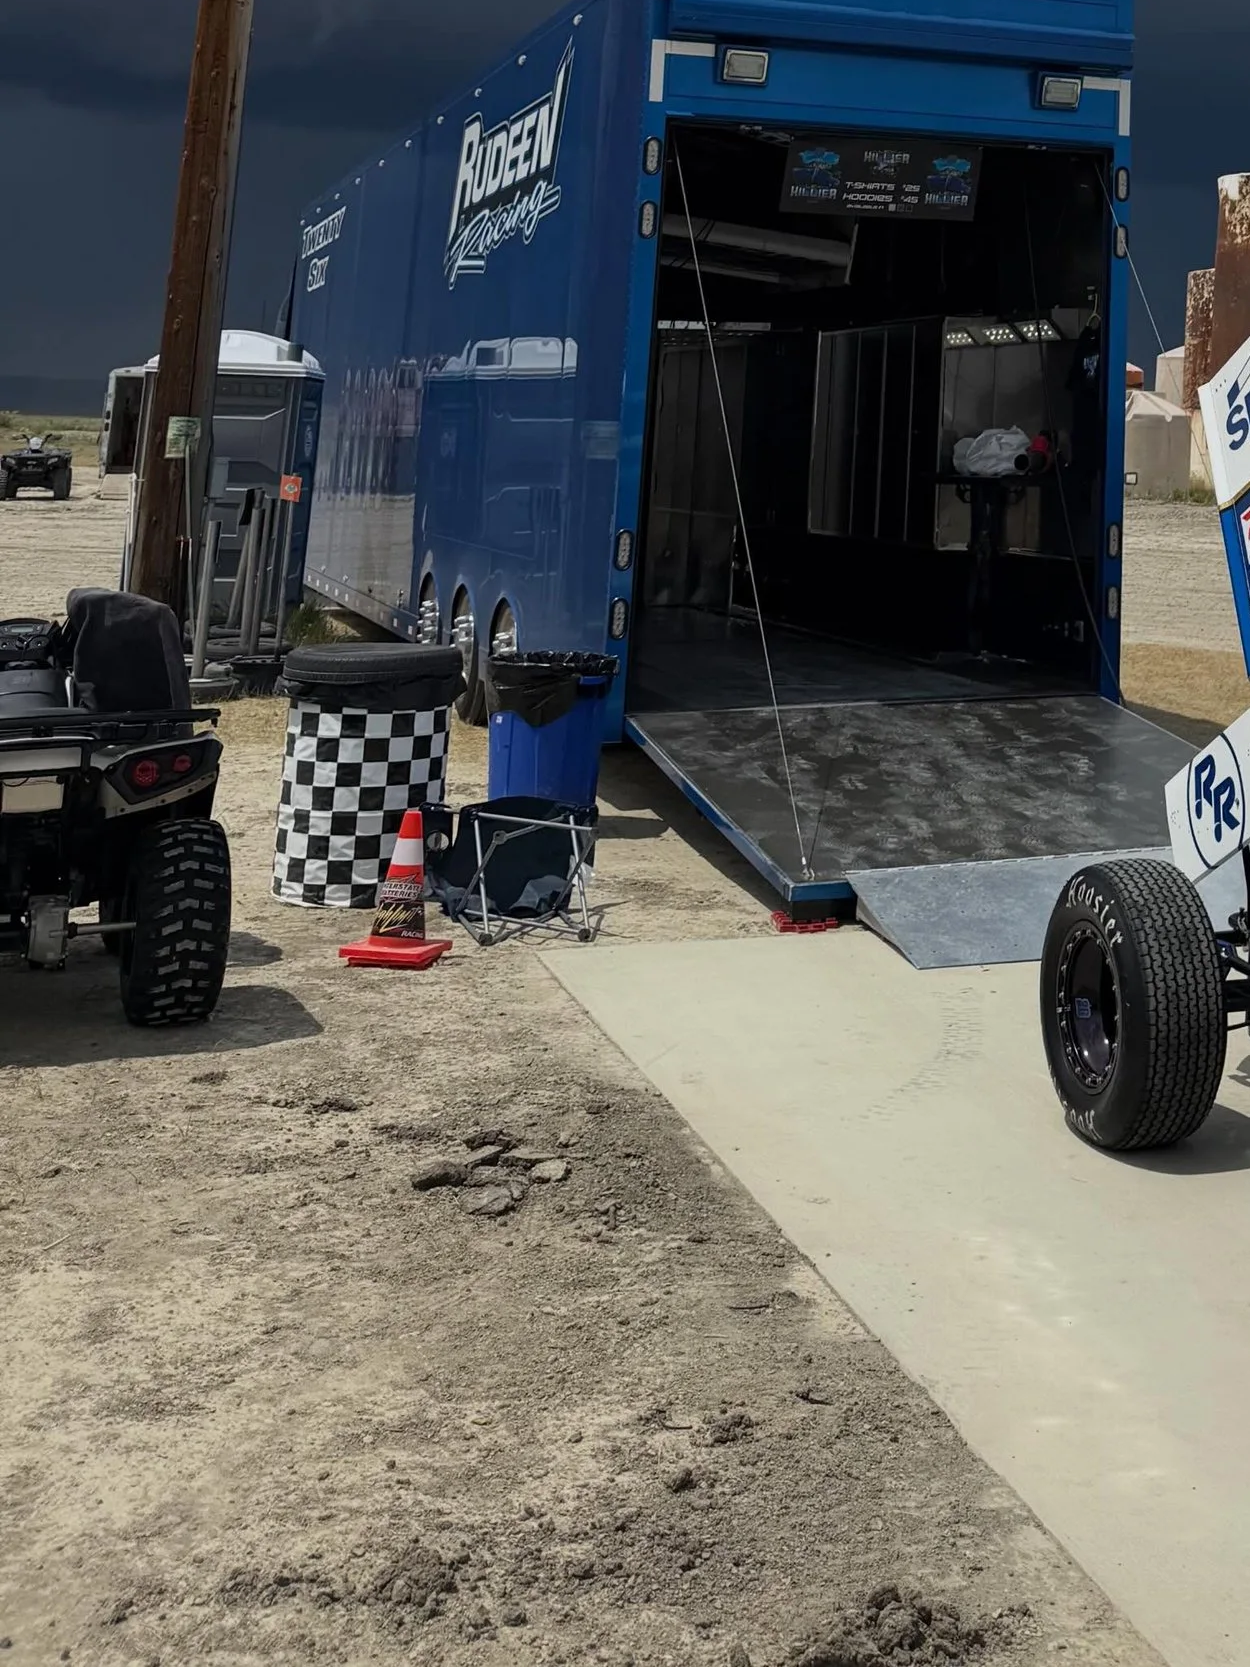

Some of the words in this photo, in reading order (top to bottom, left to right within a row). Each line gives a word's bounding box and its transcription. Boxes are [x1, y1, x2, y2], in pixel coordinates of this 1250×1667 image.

[448, 54, 570, 242] RUDEEN
[789, 185, 838, 200] HILLIER
[845, 181, 896, 191] T-SHIRTS
[924, 192, 970, 207] HILLIER
[447, 179, 562, 290] Racing
[306, 255, 330, 293] SIX
[1065, 875, 1124, 948] Hoosier
